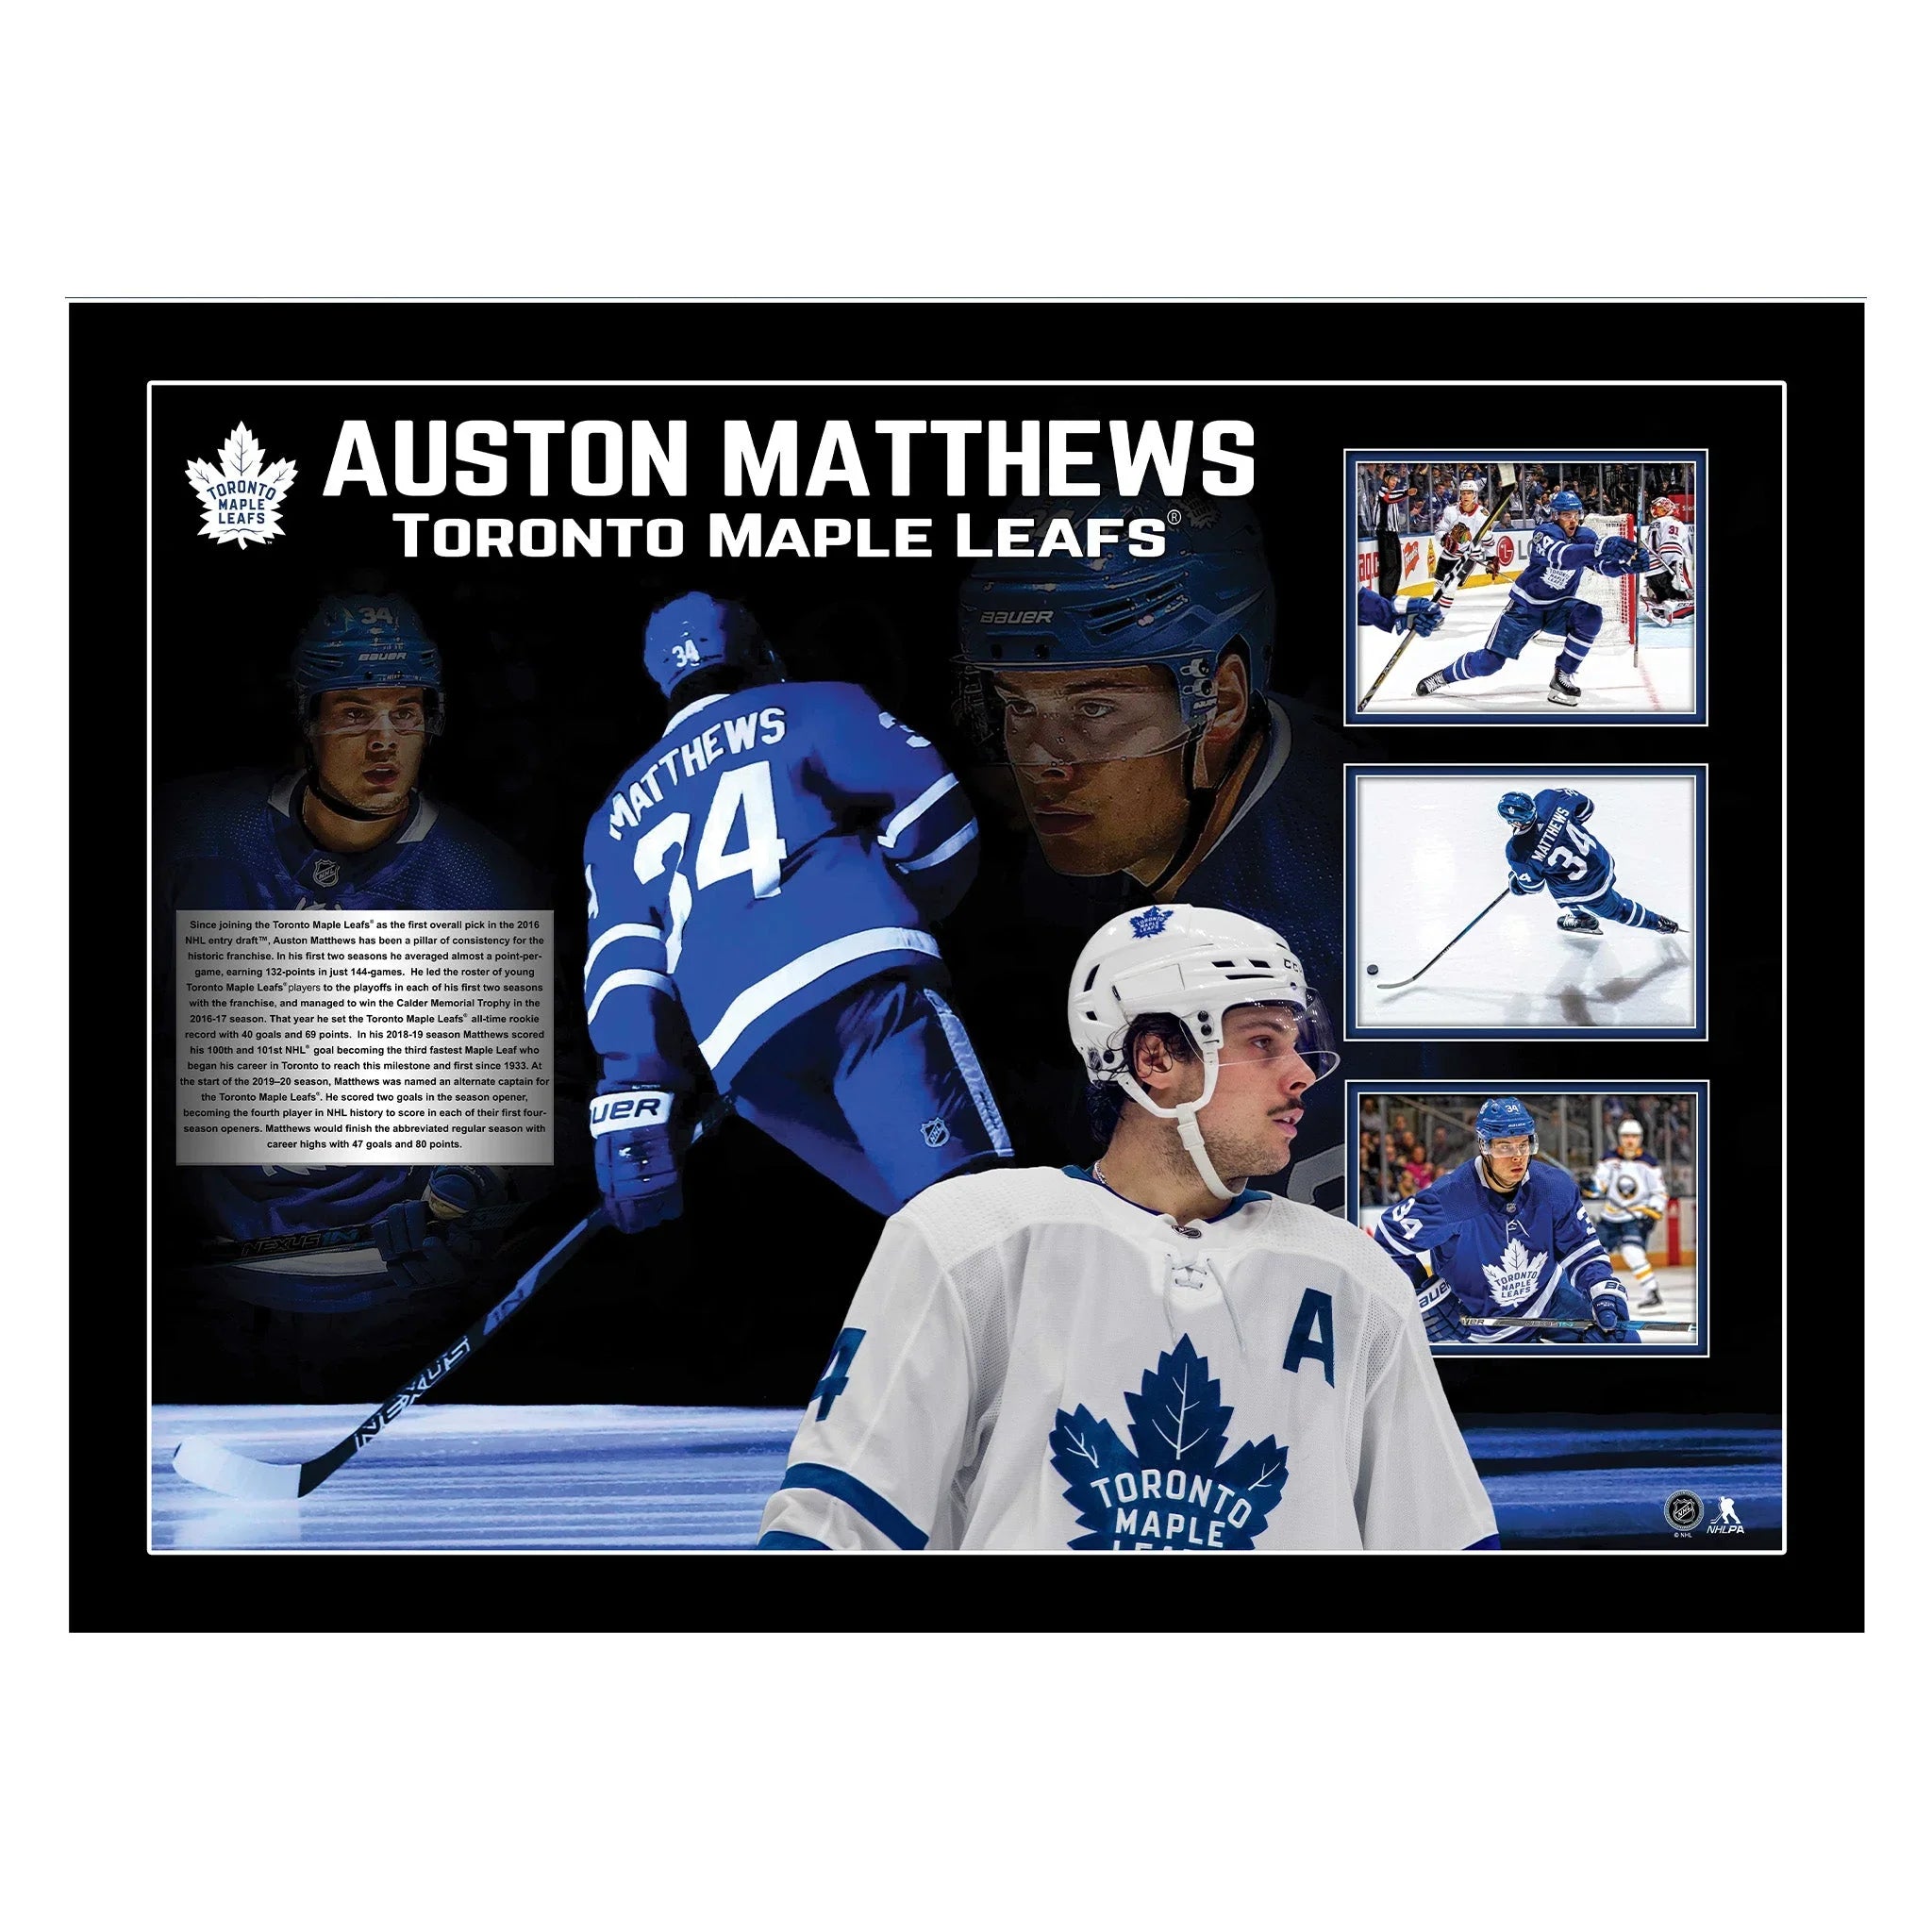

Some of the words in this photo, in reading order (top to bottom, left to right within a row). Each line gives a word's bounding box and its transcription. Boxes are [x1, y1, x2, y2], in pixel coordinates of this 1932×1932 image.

[322, 420, 687, 496] AUSTON
[724, 420, 1255, 497] MATTHEWS
[207, 480, 277, 501] TORONTO
[218, 498, 266, 510] MAPLE
[218, 512, 266, 525] LEAFS
[392, 512, 684, 558] TORONTO
[709, 512, 932, 558] MAPLE
[1669, 525, 1679, 537] 31
[358, 607, 394, 625] 34
[672, 639, 701, 668] 34
[609, 708, 786, 841] MATTHEWS
[1531, 807, 1570, 862] MATTHEWS
[1547, 818, 1597, 881] 34
[189, 920, 217, 929] Since
[218, 920, 253, 931] joining
[254, 920, 271, 929] the
[272, 920, 310, 929] Toronto
[312, 920, 341, 931] Maple
[390, 920, 406, 929] the
[408, 920, 428, 929] first
[429, 920, 462, 929] overall
[464, 920, 486, 931] pick
[487, 920, 497, 929] in
[498, 920, 515, 929] the
[516, 920, 541, 929] 2016
[185, 935, 207, 945] NHL
[208, 936, 234, 947] entry
[273, 936, 308, 945] Auston
[309, 936, 357, 945] Matthews
[358, 936, 376, 945] has
[378, 936, 403, 945] been
[413, 936, 439, 947] pillar
[440, 935, 451, 945] of
[452, 936, 511, 947] consistency
[512, 935, 527, 945] for
[528, 936, 545, 945] the
[188, 951, 225, 961] historic
[225, 951, 275, 961] franchise.
[276, 951, 286, 960] In
[288, 951, 304, 961] his
[305, 951, 325, 961] first
[326, 952, 345, 960] two
[347, 953, 388, 961] seasons
[390, 951, 403, 960] he
[404, 951, 449, 963] averaged
[451, 951, 485, 961] almost
[494, 951, 542, 963] point-per-
[194, 969, 225, 978] game,
[225, 967, 263, 979] earning
[265, 967, 316, 978] 132-points
[318, 967, 327, 976] in
[328, 967, 349, 978] just
[350, 967, 406, 978] 144-games.
[410, 967, 425, 976] He
[425, 967, 441, 976] led
[442, 967, 459, 976] the
[460, 966, 491, 976] roster
[491, 967, 504, 976] of
[504, 969, 535, 978] young
[1283, 958, 1303, 973] CC
[185, 982, 225, 994] Toronto
[225, 982, 255, 994] Maple
[288, 982, 322, 994] players
[323, 983, 334, 992] to
[335, 982, 351, 992] the
[353, 982, 392, 994] playoffs
[394, 982, 404, 992] in
[406, 982, 429, 992] each
[431, 982, 442, 992] of
[443, 982, 459, 992] his
[460, 982, 481, 992] first
[482, 983, 501, 992] two
[503, 984, 543, 992] seasons
[179, 1076, 195, 1087] the
[197, 1077, 221, 1087] start
[222, 1076, 233, 1086] of
[233, 1076, 250, 1087] the
[293, 1078, 332, 1088] season,
[334, 1076, 380, 1086] Matthews
[404, 1076, 437, 1086] named
[453, 1076, 496, 1086] alternate
[497, 1076, 534, 1088] captain
[535, 1076, 550, 1086] for
[1505, 1104, 1520, 1113] 34
[220, 1125, 263, 1135] openers.
[265, 1124, 311, 1133] Matthews
[313, 1124, 343, 1133] would
[344, 1124, 373, 1133] finish
[374, 1124, 391, 1133] the
[392, 1124, 449, 1133] abbreviated
[451, 1124, 487, 1135] regular
[525, 1124, 546, 1133] with
[266, 1141, 298, 1149] career
[299, 1139, 327, 1151] highs
[328, 1139, 350, 1149] with
[351, 1140, 364, 1149] 47
[365, 1140, 392, 1151] goals
[394, 1140, 413, 1149] and
[415, 1139, 427, 1149] 80
[429, 1139, 462, 1151] points.
[1391, 1197, 1424, 1241] 34
[242, 1232, 322, 1257] NEXUS
[1494, 1271, 1539, 1287] TORONTO
[1501, 1279, 1531, 1291] MAPLE
[1501, 1286, 1531, 1298] LEAFS
[1282, 1287, 1335, 1389] A
[355, 1335, 472, 1451] NEXUS
[1090, 1468, 1252, 1529] TORONTO
[1677, 1506, 1691, 1518] NHL
[1114, 1507, 1226, 1549] MAPLE
[1706, 1524, 1745, 1534] NHLPA
